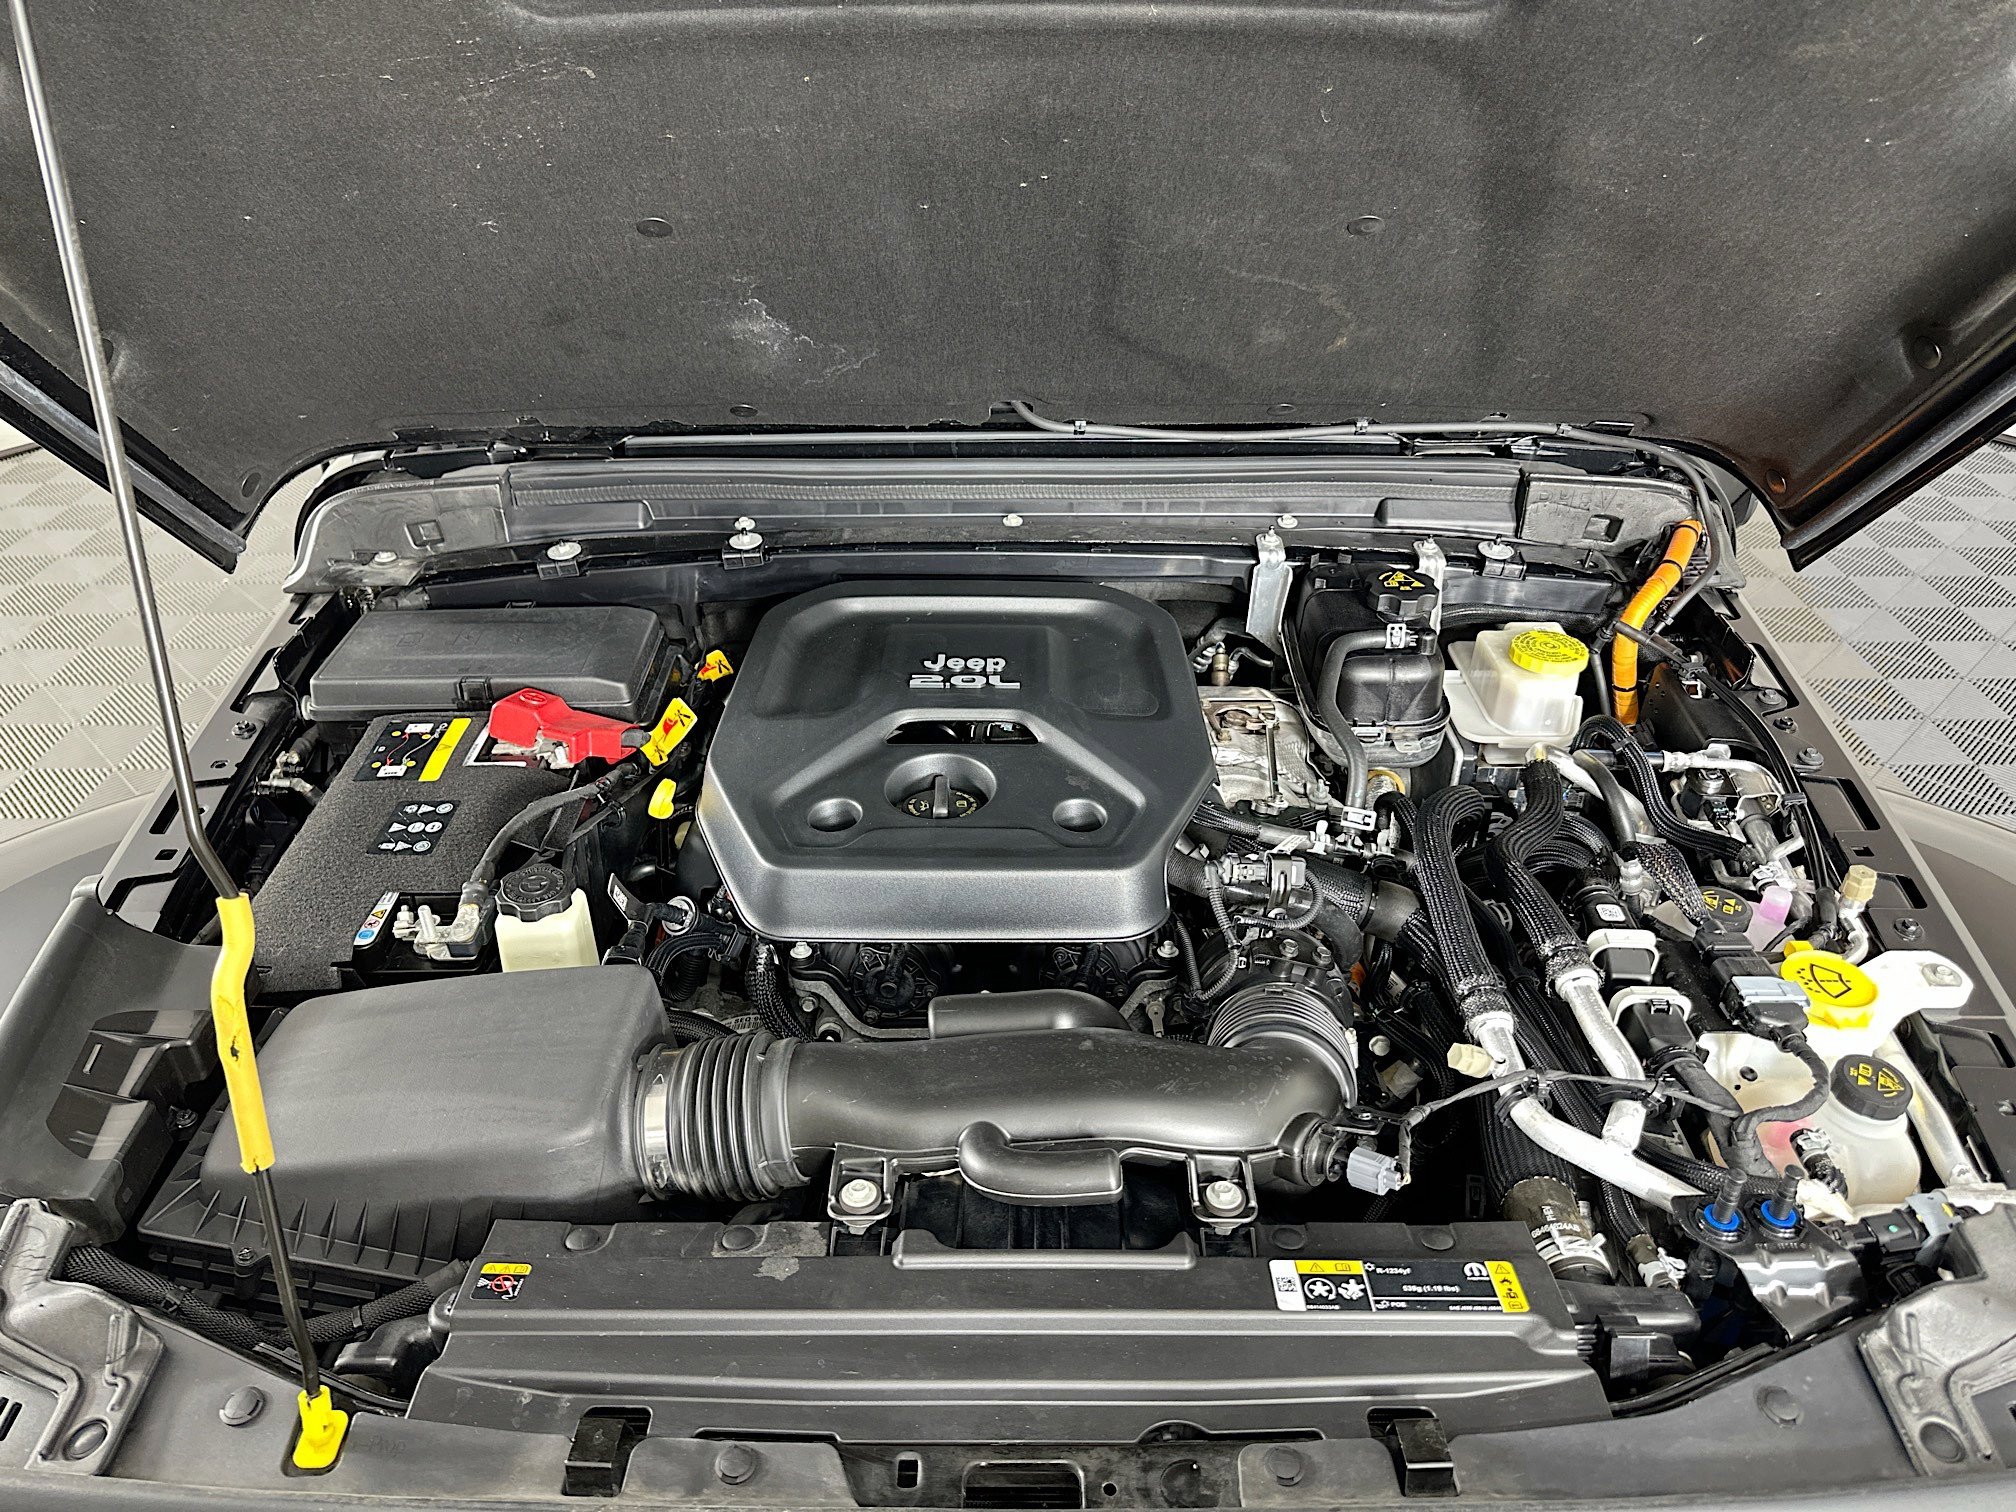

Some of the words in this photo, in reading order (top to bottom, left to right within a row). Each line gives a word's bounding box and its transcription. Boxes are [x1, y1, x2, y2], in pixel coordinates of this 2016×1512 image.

[923, 653, 1006, 674] Jeep
[909, 674, 1020, 689] 2.0L
[1376, 1267, 1411, 1275] R-1234yf
